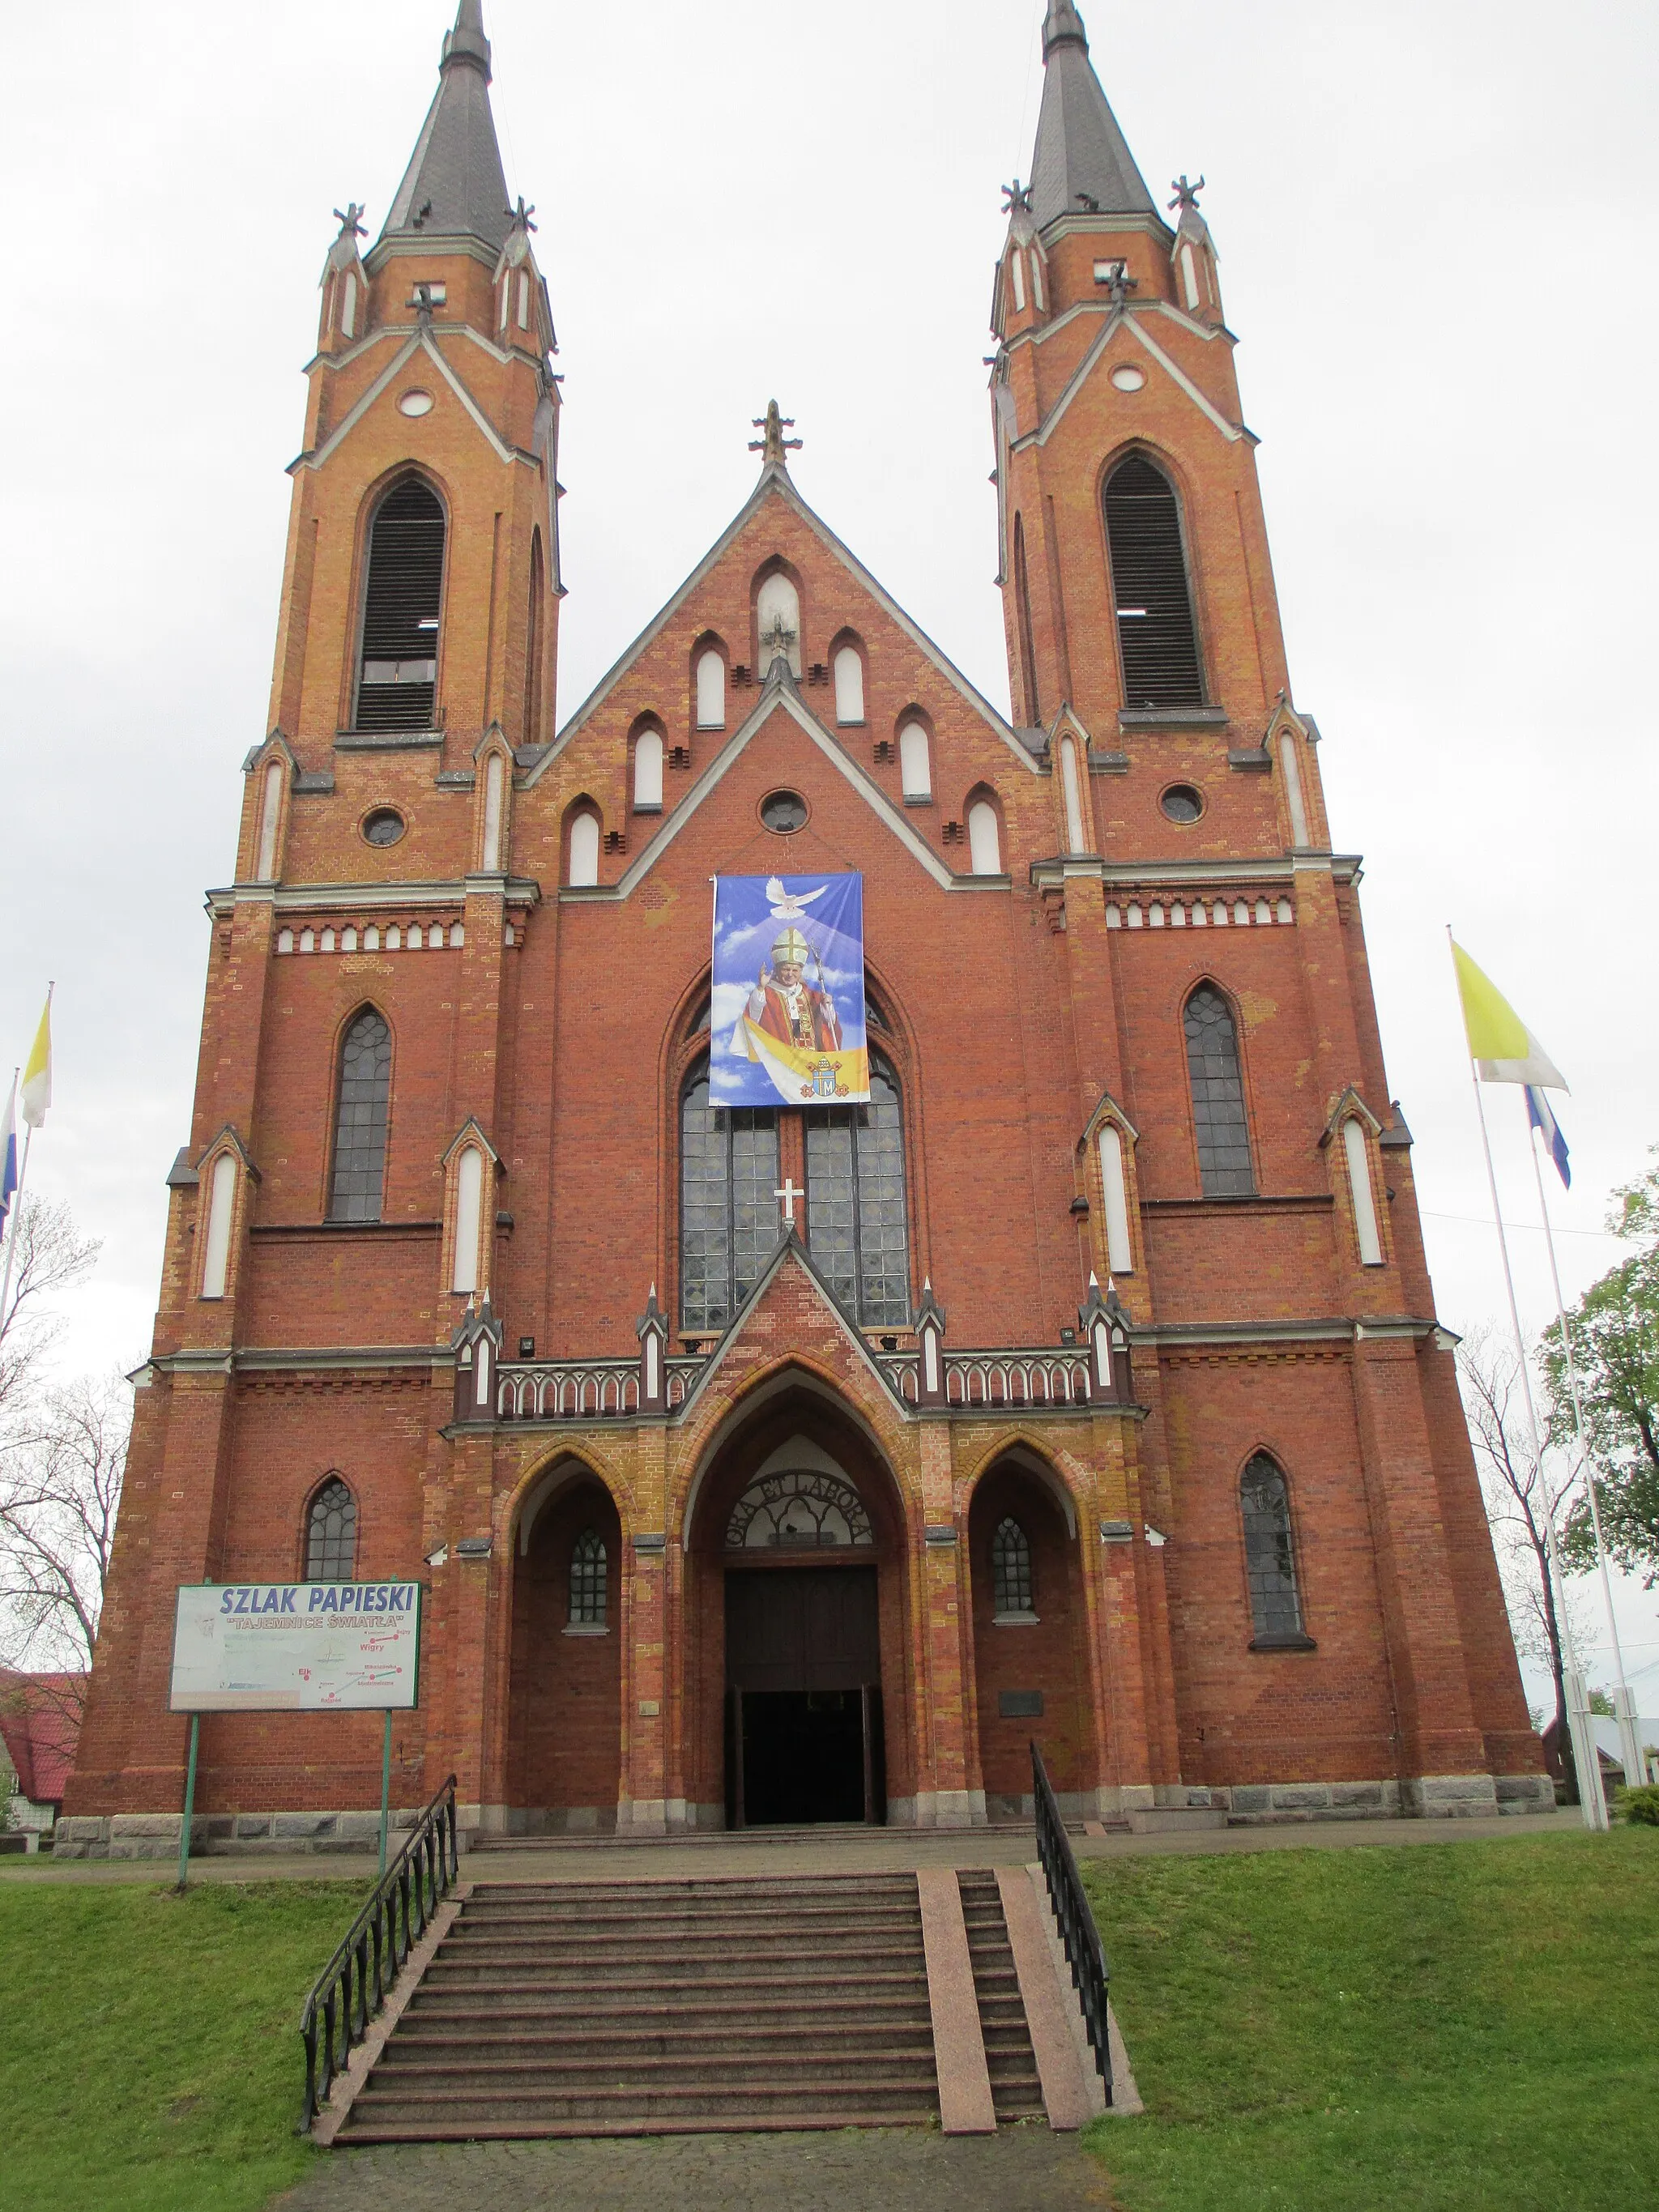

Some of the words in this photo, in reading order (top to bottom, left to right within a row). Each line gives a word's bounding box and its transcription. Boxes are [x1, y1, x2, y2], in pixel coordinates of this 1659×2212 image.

[726, 1500, 759, 1545] ORA
[759, 1477, 786, 1499] ET
[794, 1473, 872, 1540] LABORA
[220, 1588, 297, 1613] SZLAK
[309, 1585, 414, 1613] PAPIESKI
[360, 1643, 384, 1652] Wigry
